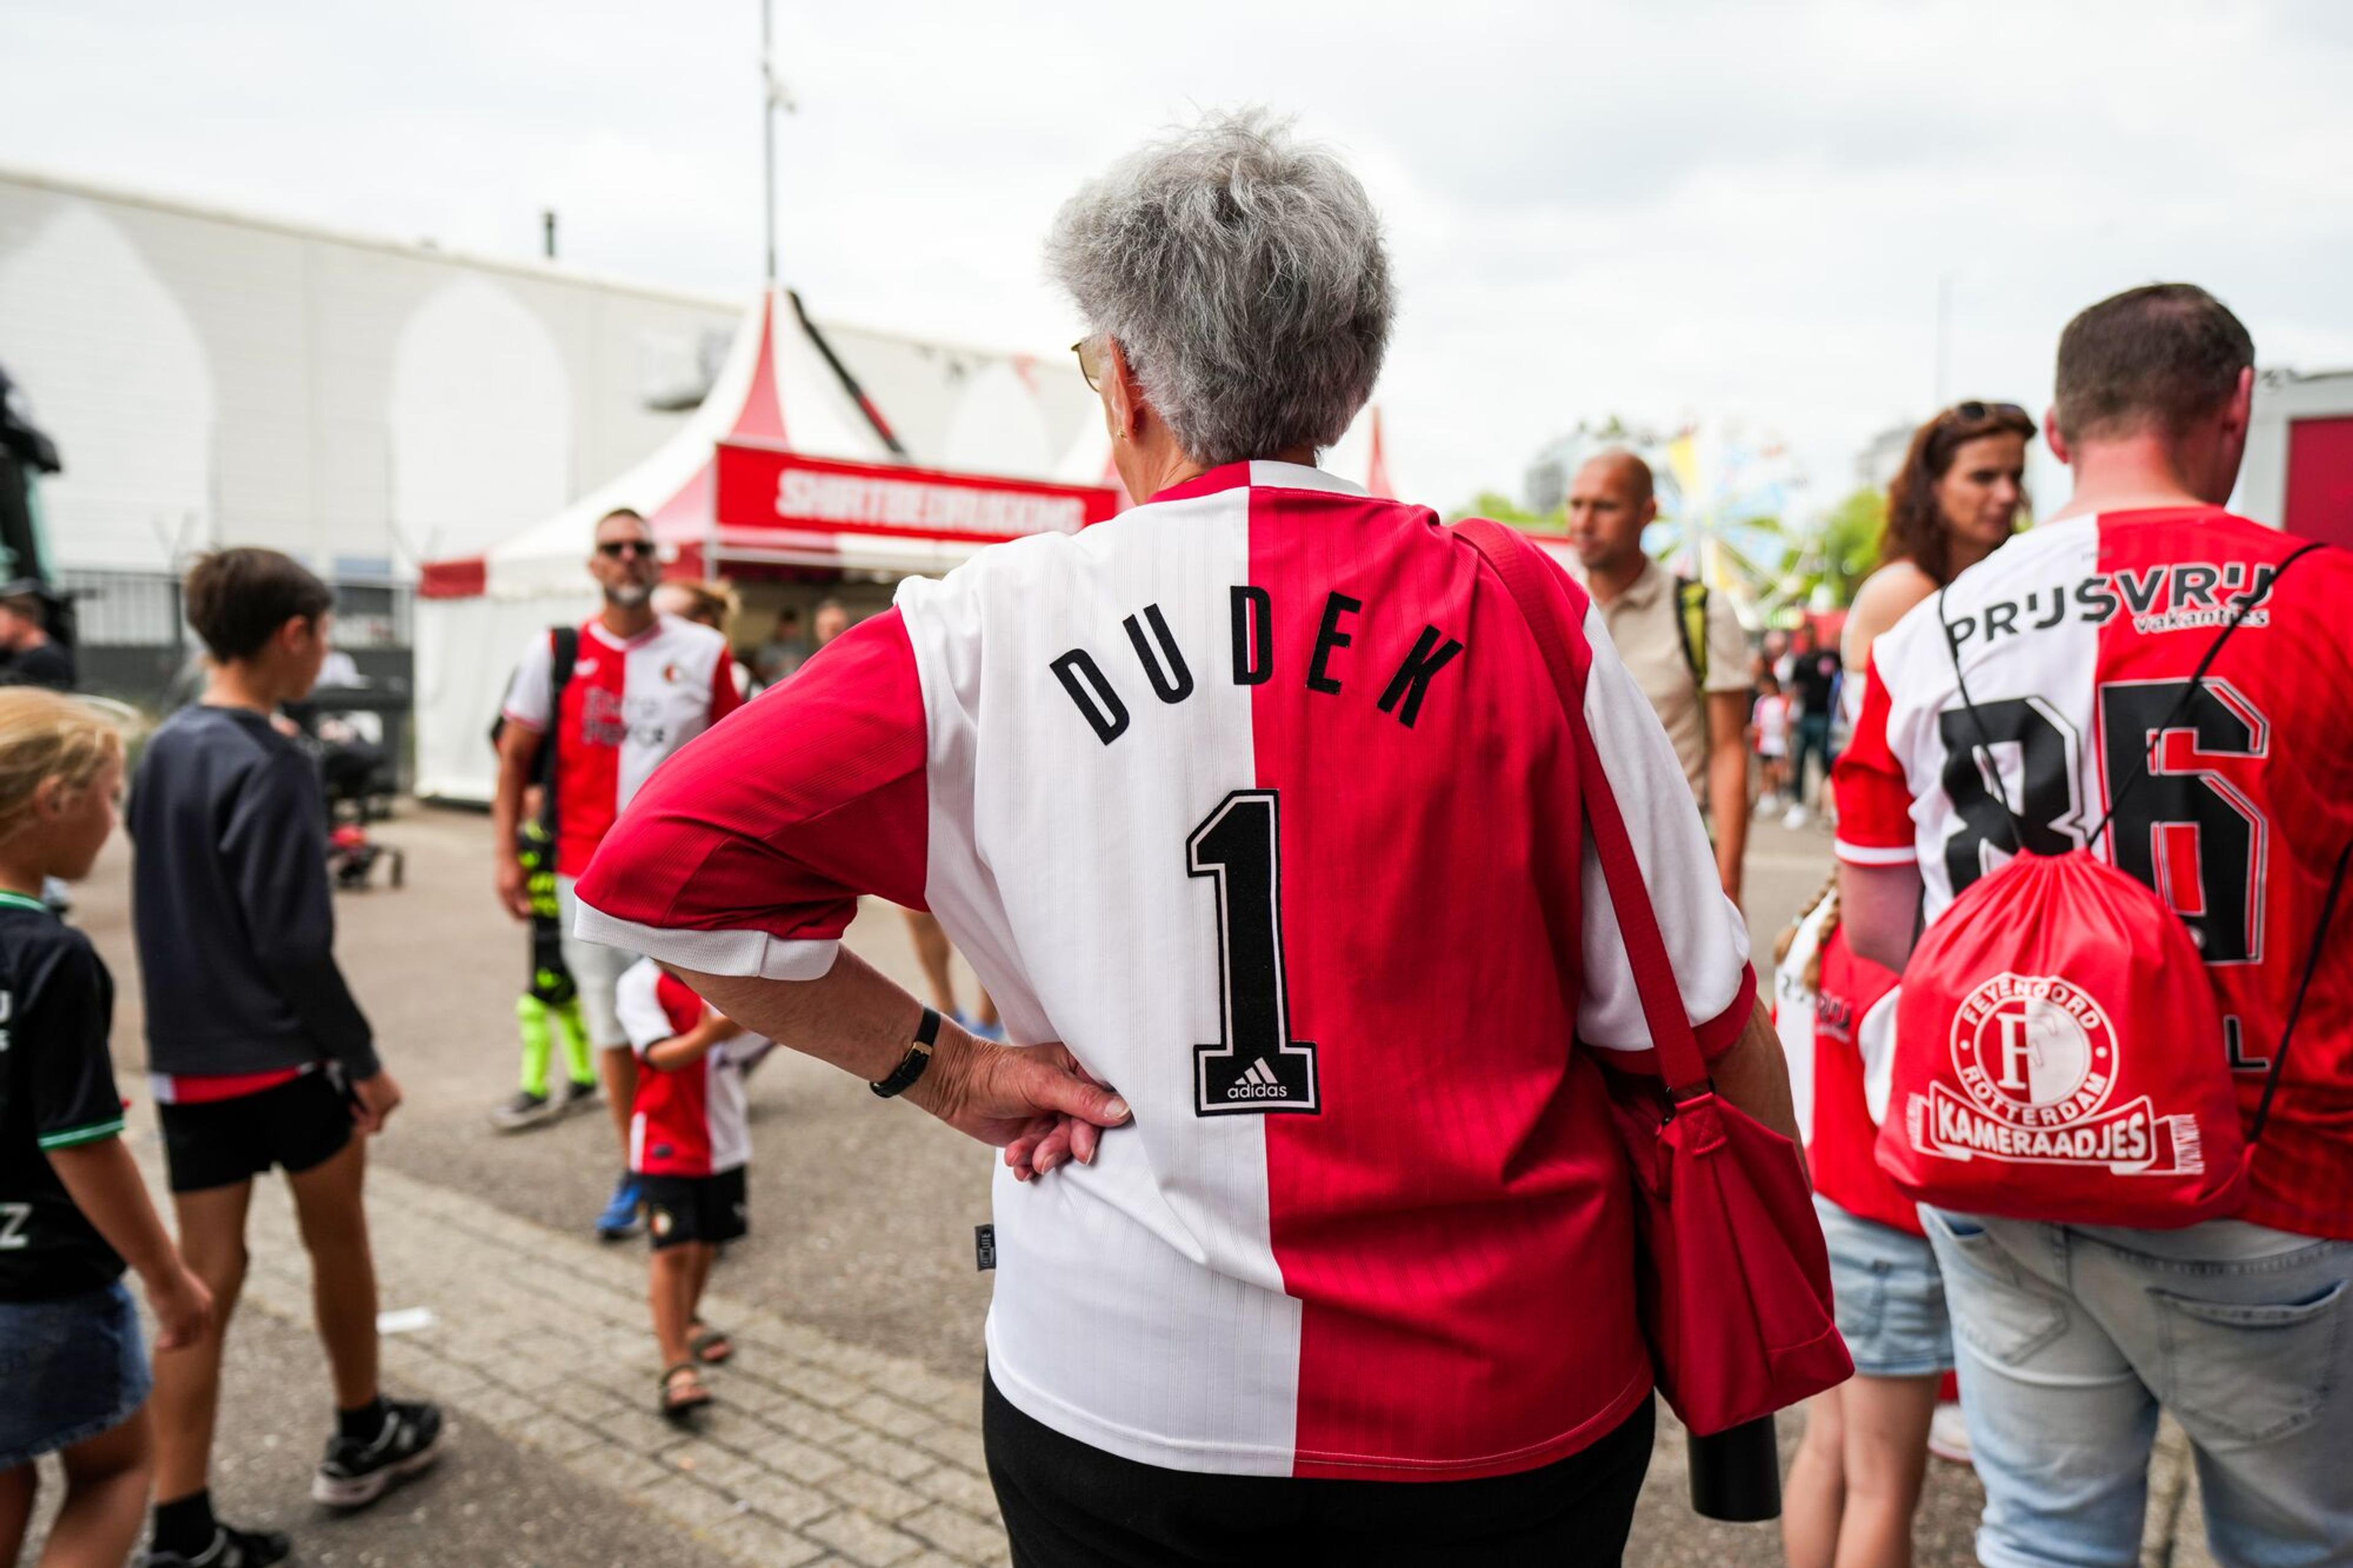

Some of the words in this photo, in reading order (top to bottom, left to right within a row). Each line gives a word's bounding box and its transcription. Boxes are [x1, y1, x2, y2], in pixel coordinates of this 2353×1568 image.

[1050, 585, 1464, 746] DUDEK
[1186, 789, 1320, 1117] 1
[1963, 979, 2101, 1029] FEYENOORD
[1227, 1083, 1287, 1099] adidas
[1962, 1065, 2107, 1126] ROTTERDAM
[1938, 1096, 2147, 1159] KAMERAADJES
